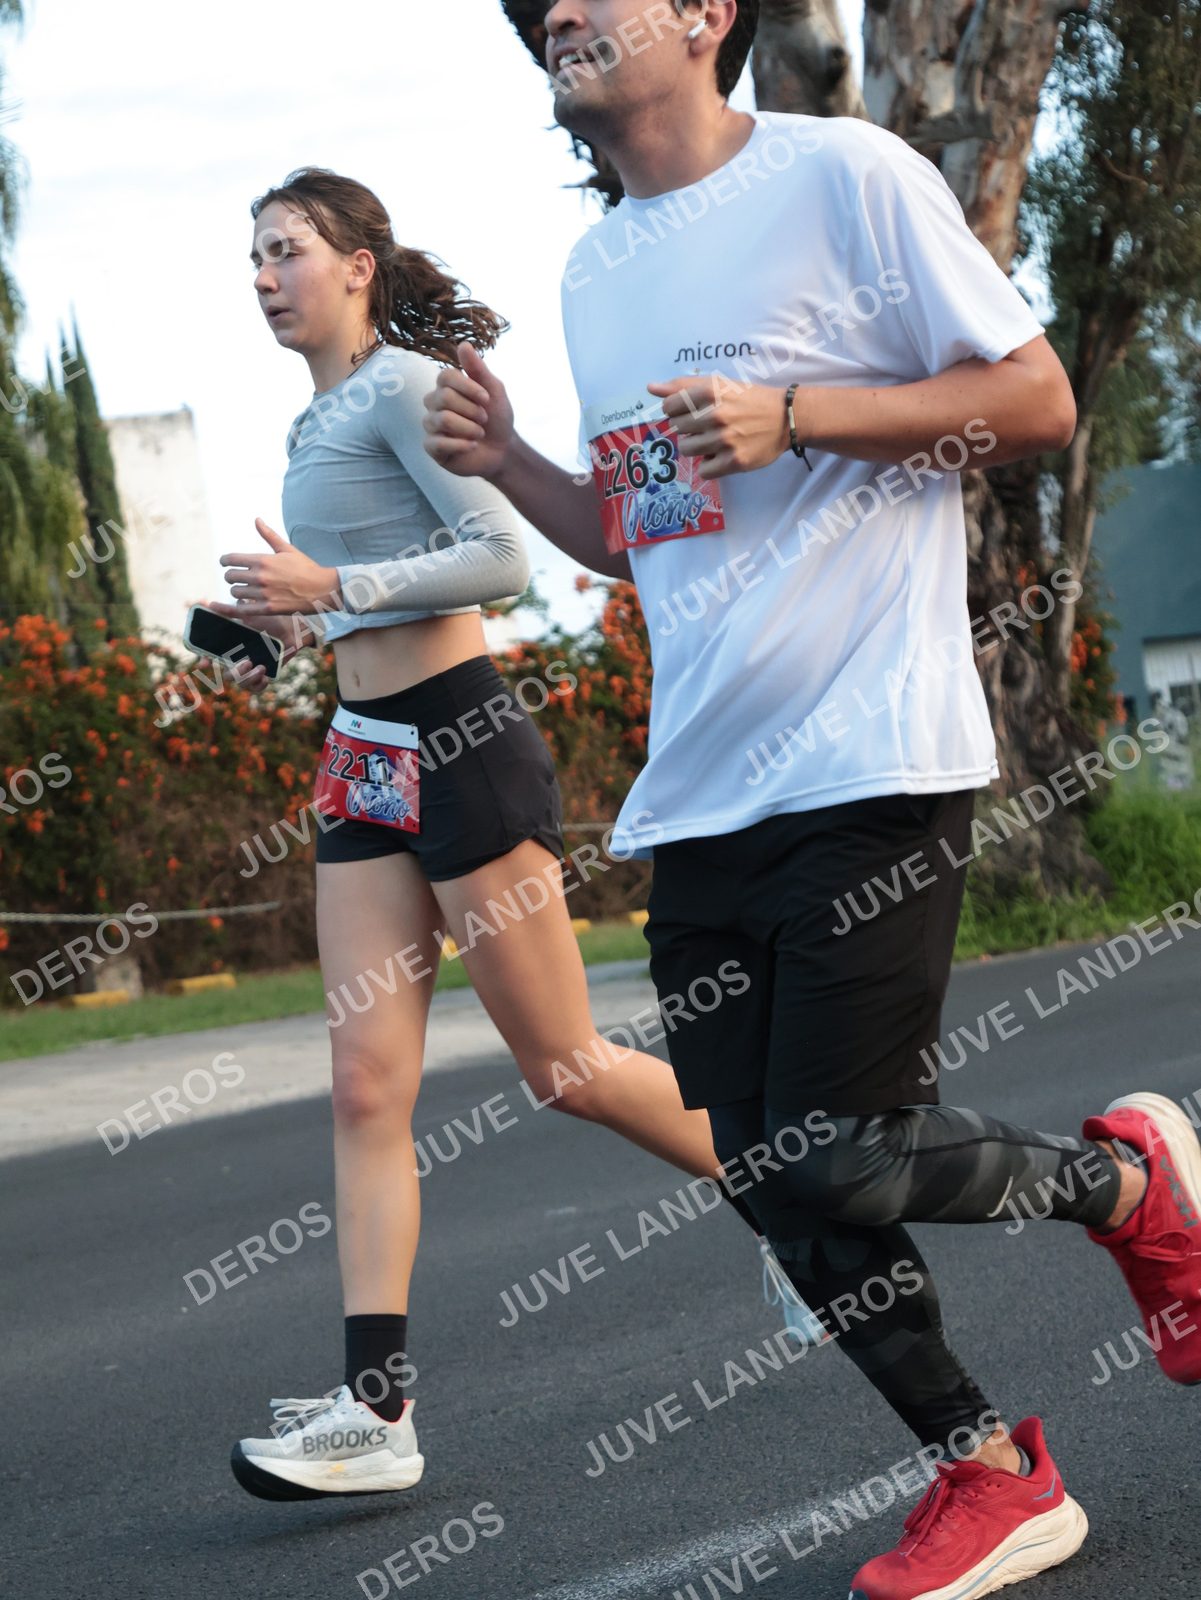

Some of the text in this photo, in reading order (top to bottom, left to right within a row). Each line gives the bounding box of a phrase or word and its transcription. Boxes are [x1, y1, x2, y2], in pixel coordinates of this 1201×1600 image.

[674, 341, 757, 363] micron
[601, 406, 636, 426] Openbank
[601, 438, 678, 499] 2263
[328, 743, 394, 787] 2211
[302, 1426, 387, 1454] BROOKS
